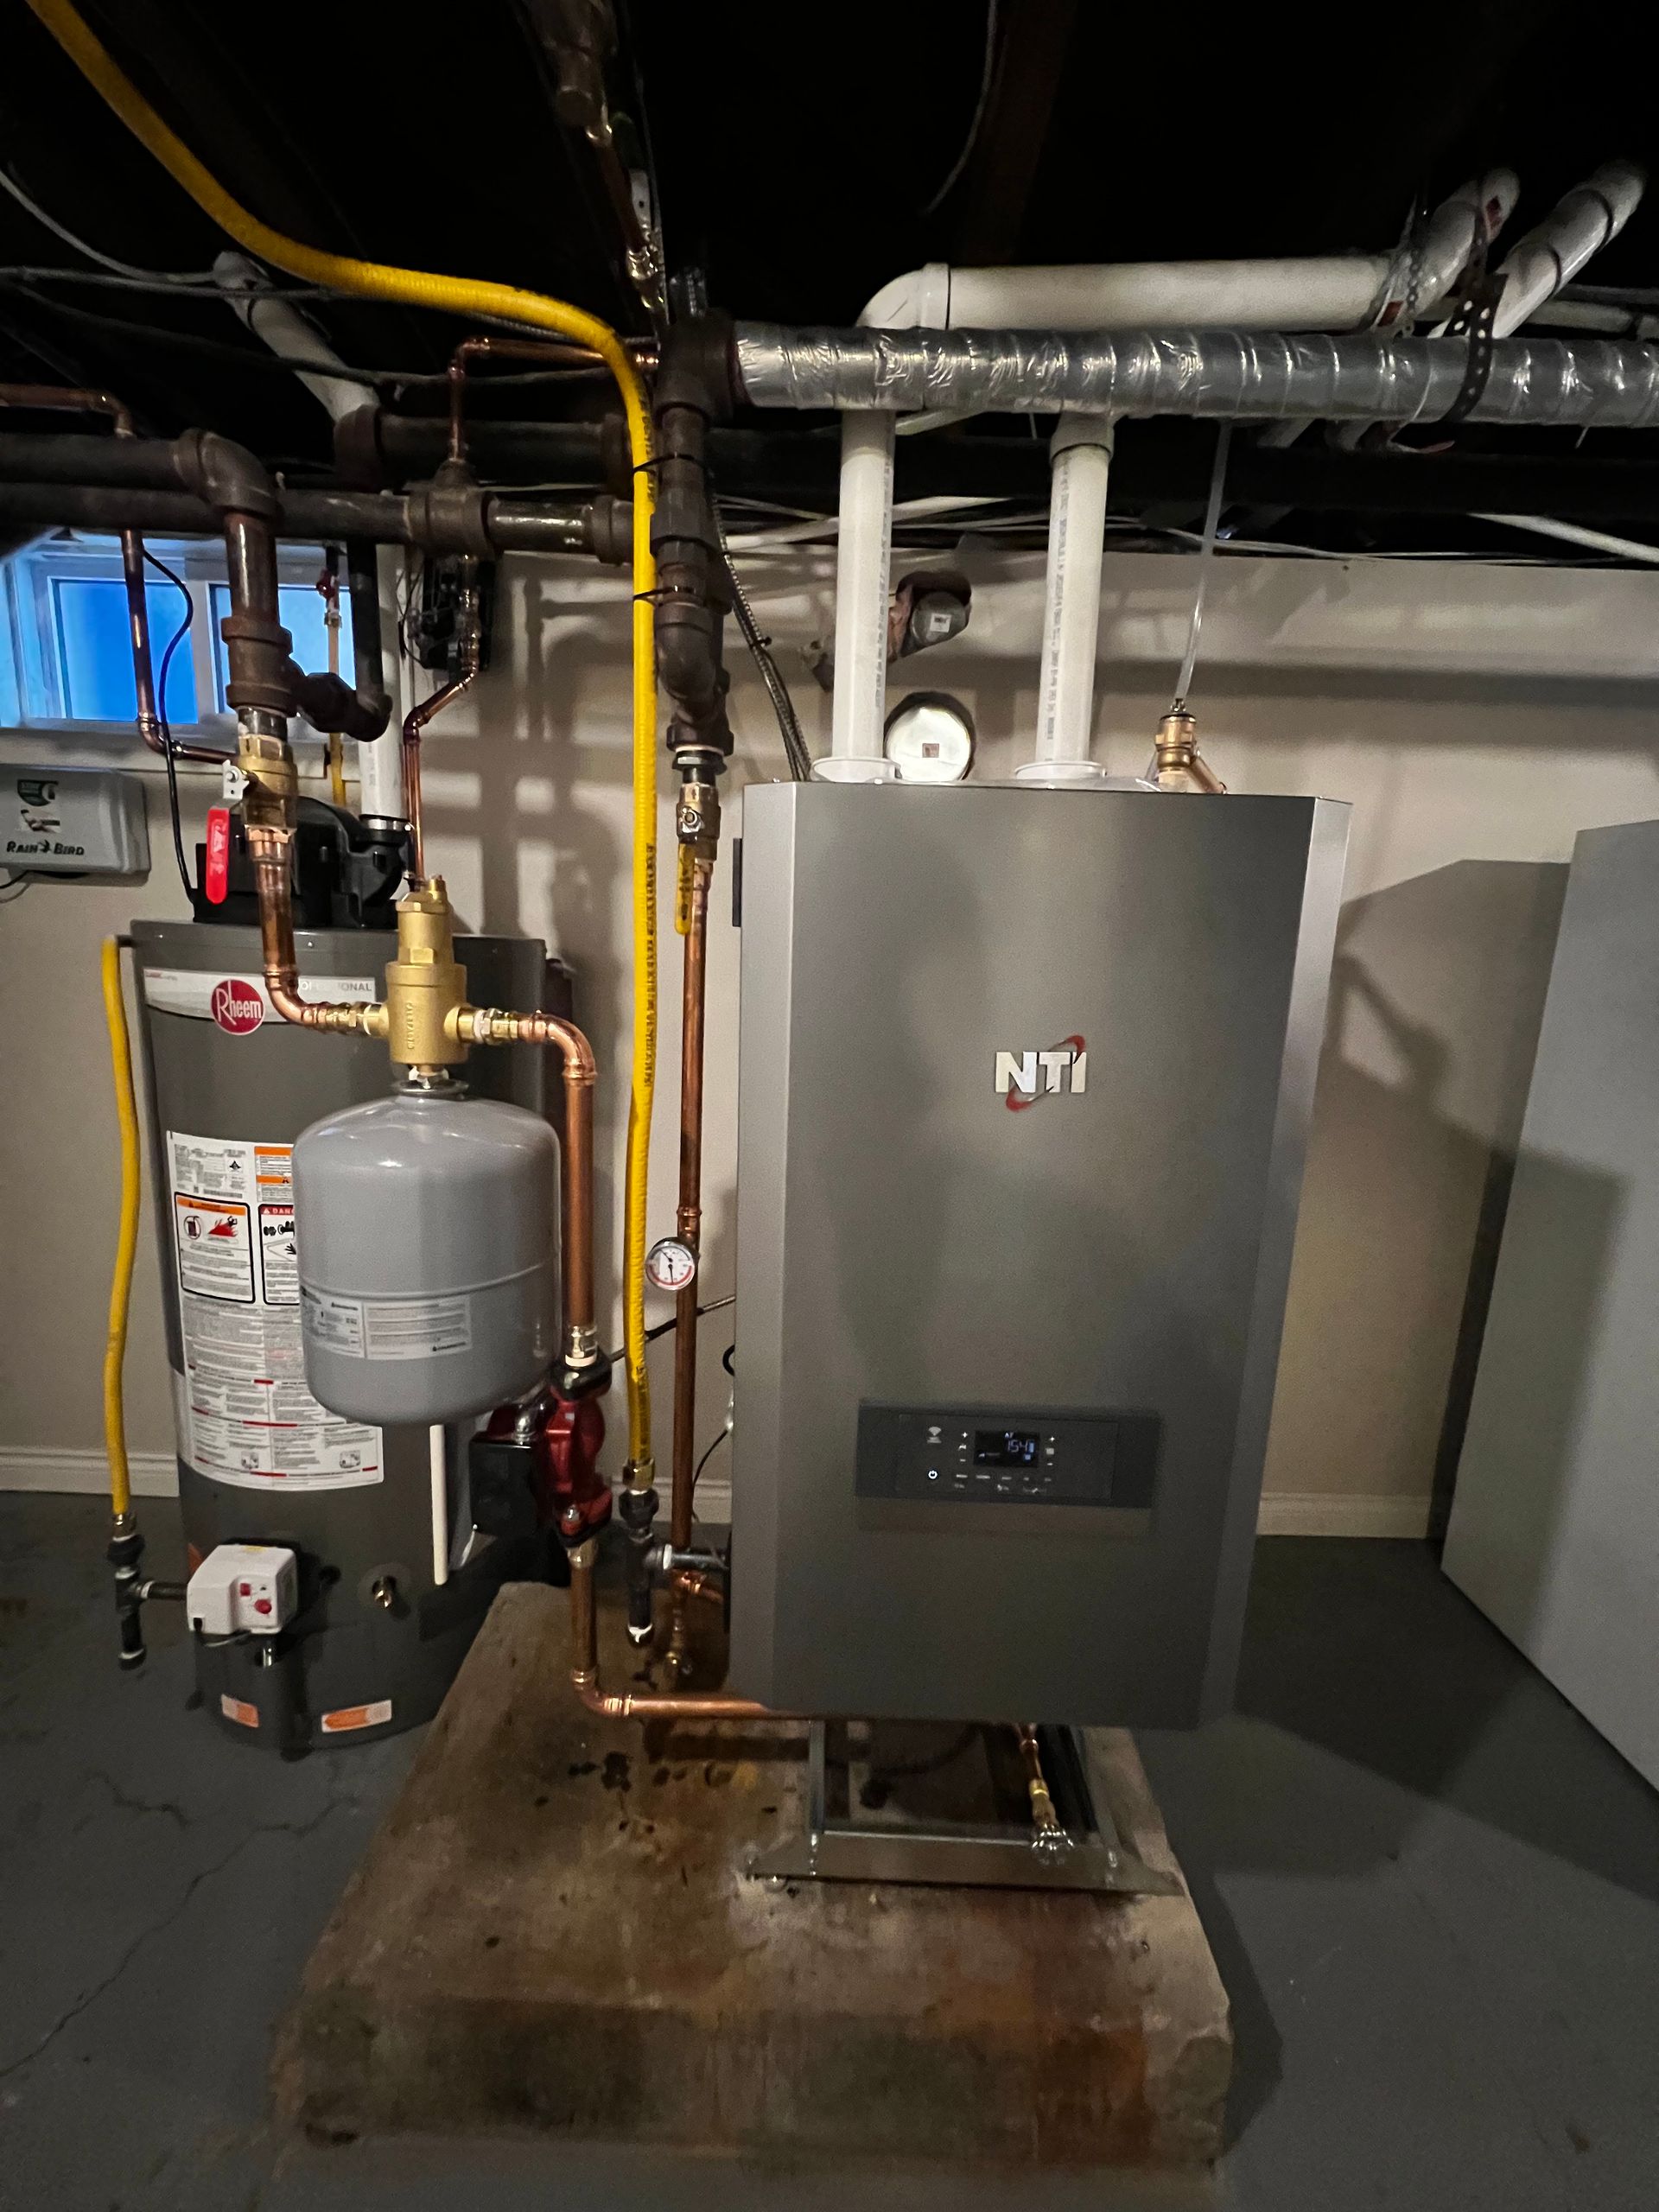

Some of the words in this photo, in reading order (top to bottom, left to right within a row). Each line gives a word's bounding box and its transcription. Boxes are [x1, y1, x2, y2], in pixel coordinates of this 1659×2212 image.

[6, 841, 38, 854] RAIN
[54, 842, 85, 856] BIRD
[216, 981, 262, 1026] Rheem
[995, 1052, 1087, 1093] NTI
